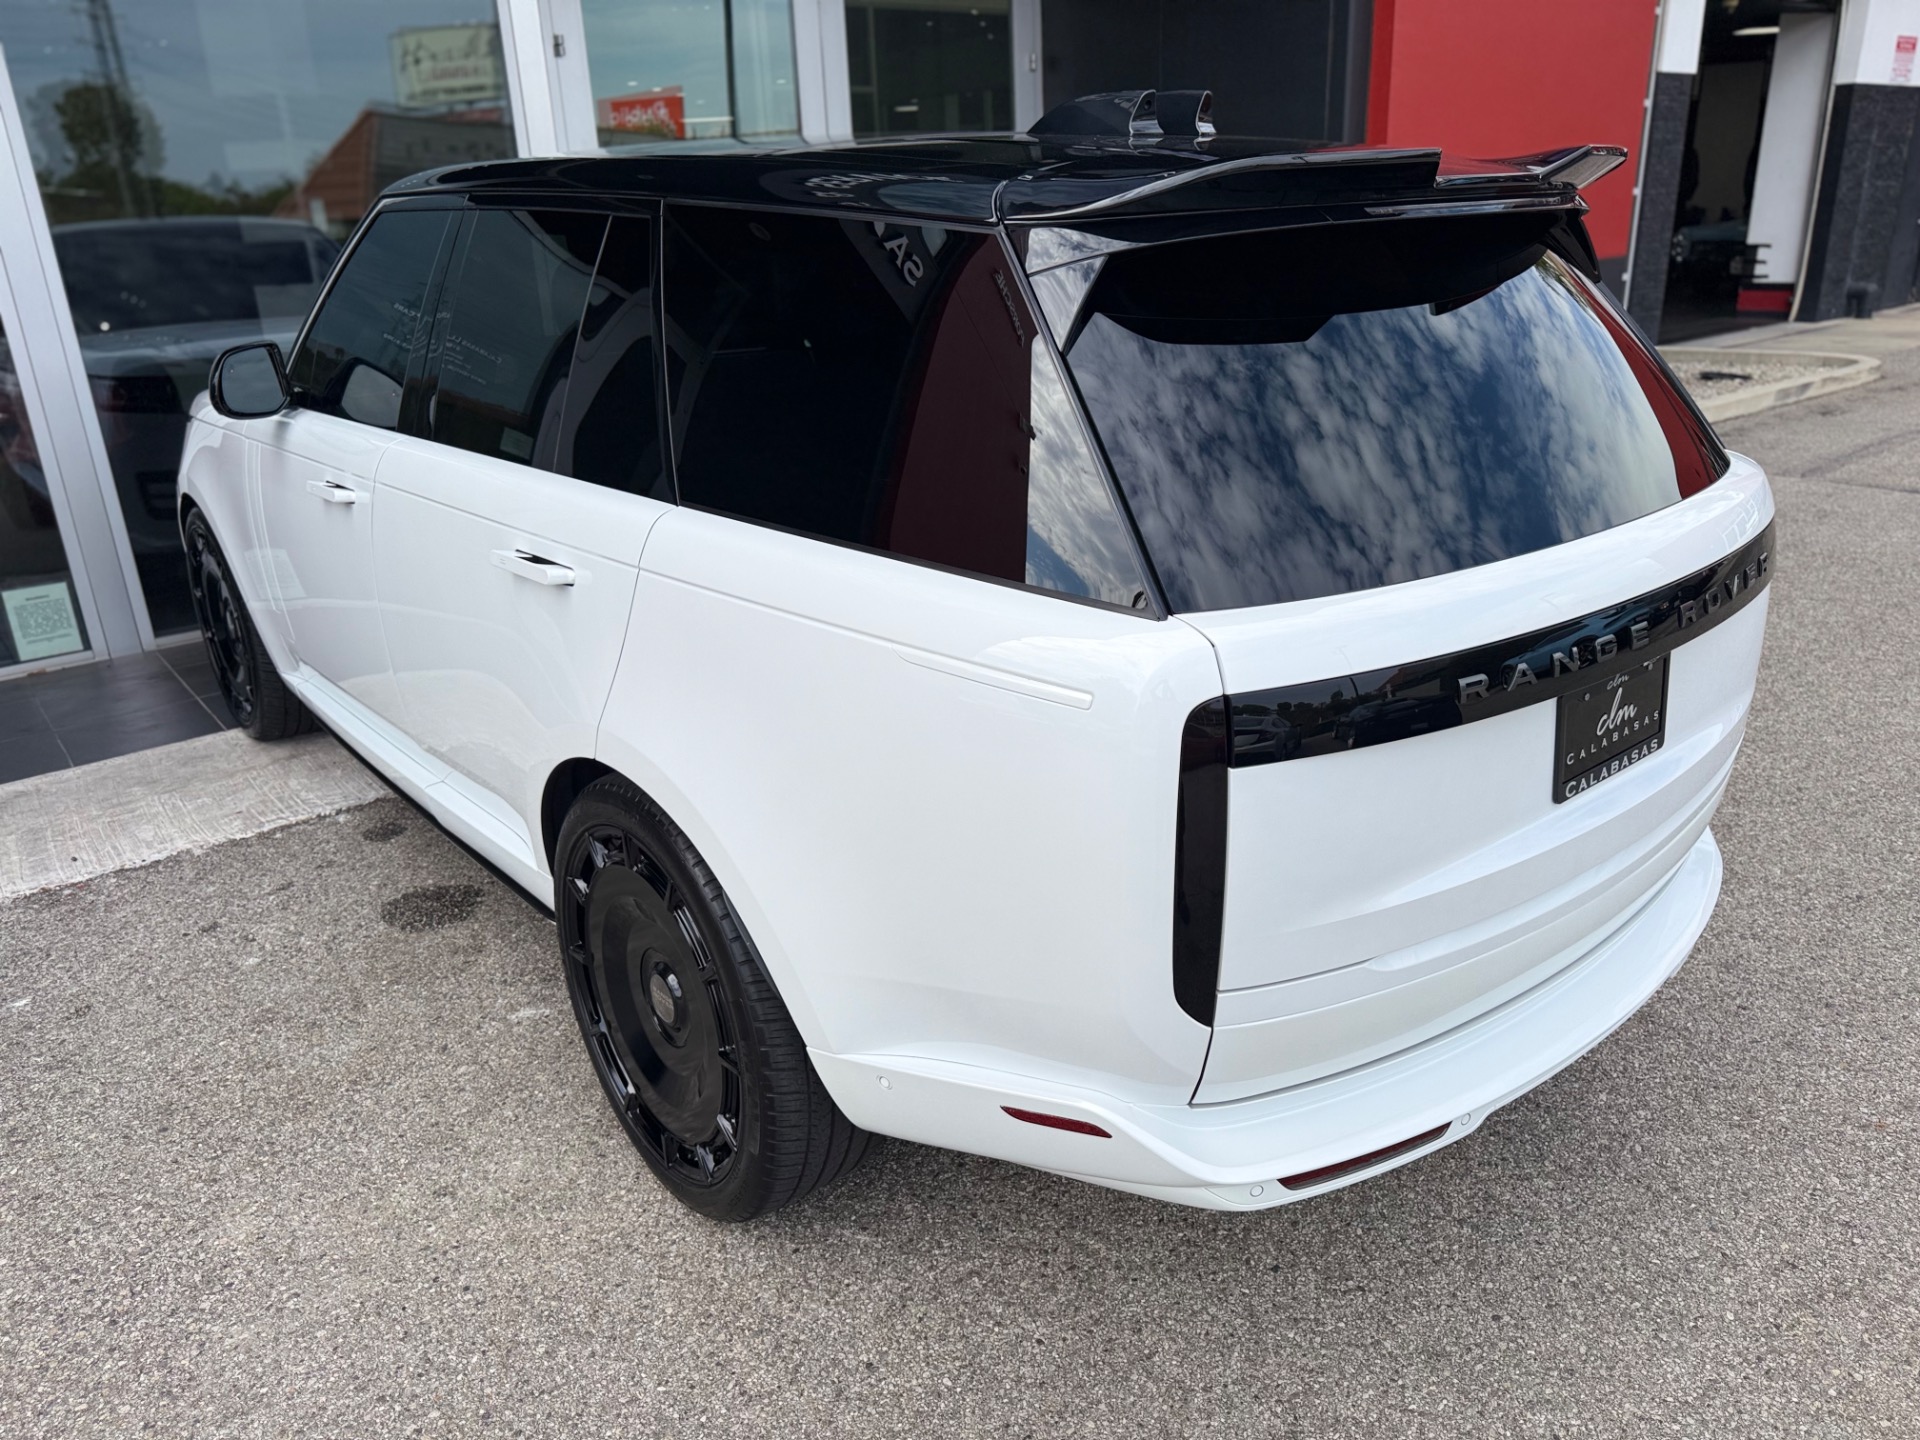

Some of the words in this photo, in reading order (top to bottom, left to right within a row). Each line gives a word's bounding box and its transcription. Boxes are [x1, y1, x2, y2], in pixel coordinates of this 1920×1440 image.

[1457, 620, 1652, 705] RANGE
[1677, 551, 1770, 629] ROVER
[1566, 710, 1660, 766] CALABASAS
[1596, 686, 1638, 736] clm
[1565, 738, 1660, 798] CALABASAS
